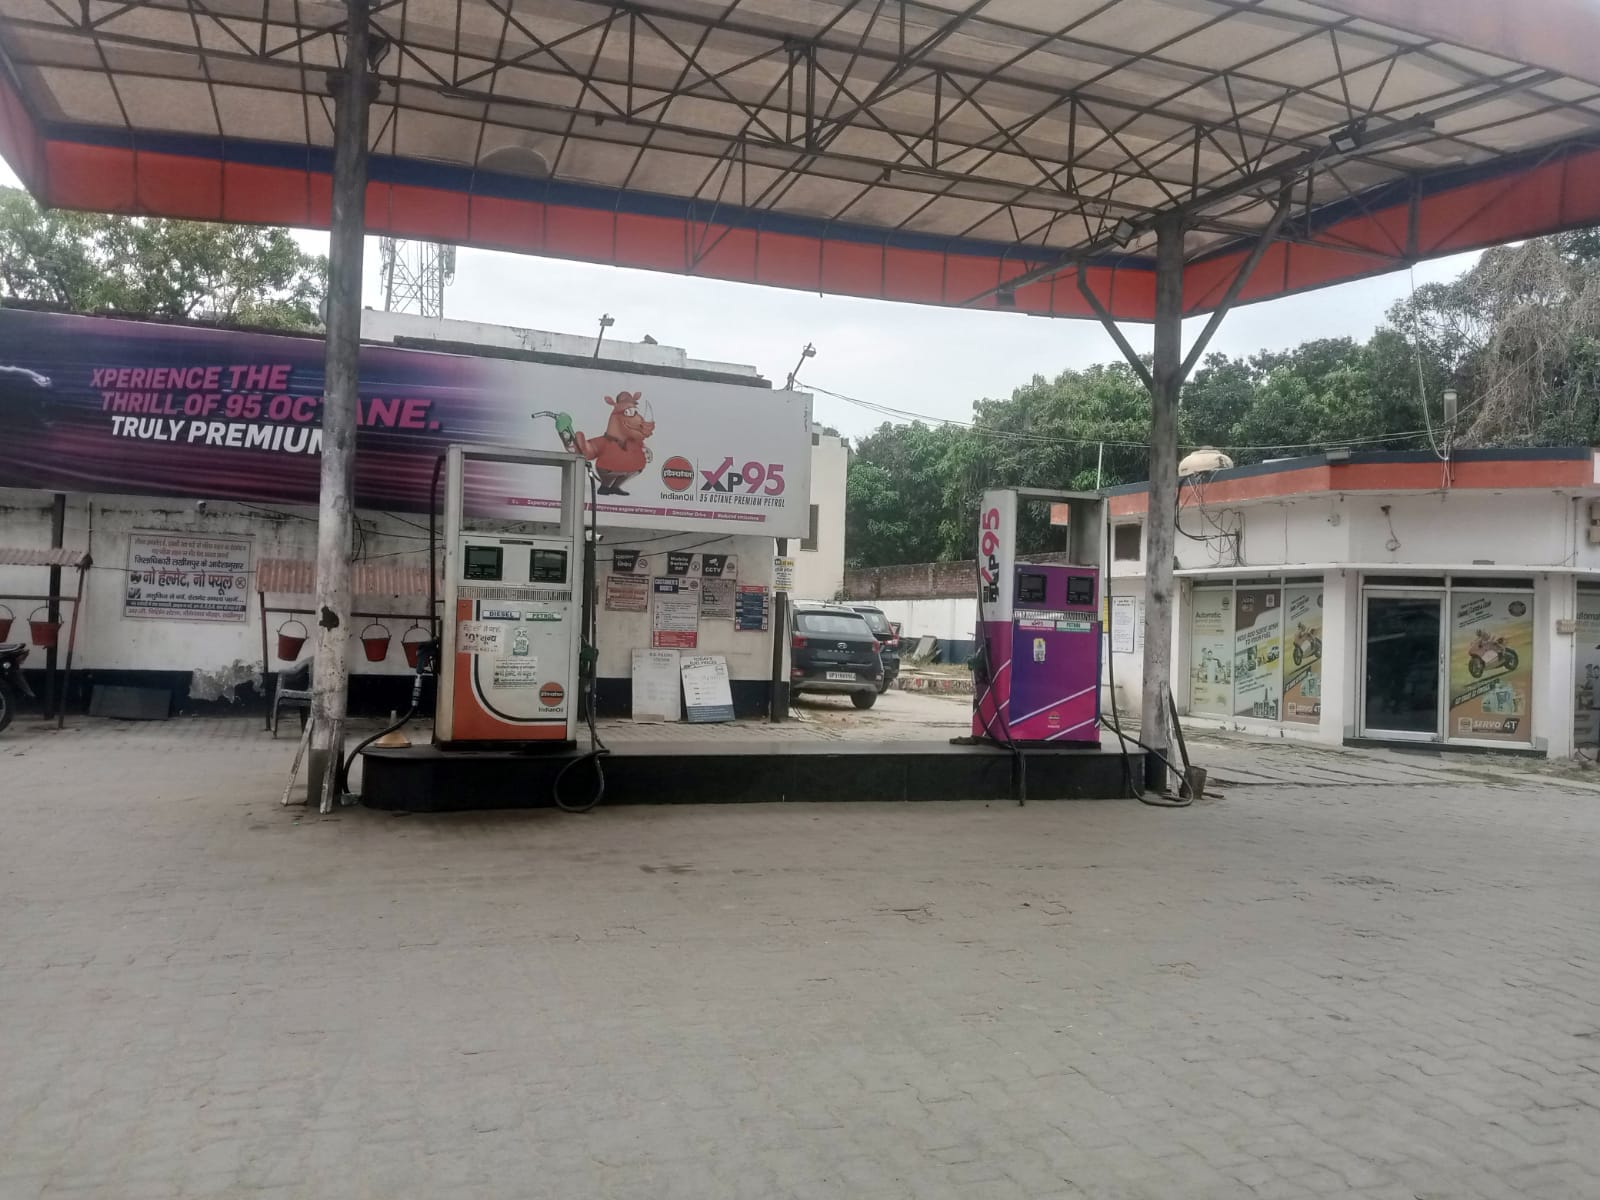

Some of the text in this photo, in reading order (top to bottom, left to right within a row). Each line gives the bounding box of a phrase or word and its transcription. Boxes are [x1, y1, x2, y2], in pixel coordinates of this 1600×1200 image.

[90, 364, 292, 390] XPERIENCE THE
[102, 391, 440, 429] THRILL OF 95 OCNE.
[111, 415, 185, 442] TRULY
[700, 457, 785, 496] XP95
[660, 491, 694, 501] IndianOil
[710, 494, 732, 505] OCTANE
[734, 496, 762, 506] PREMIUM
[764, 498, 785, 508] PETROL
[143, 567, 155, 585] नो
[193, 569, 205, 587] नो
[489, 610, 514, 618] DIESEL
[1504, 718, 1517, 730] 4T
